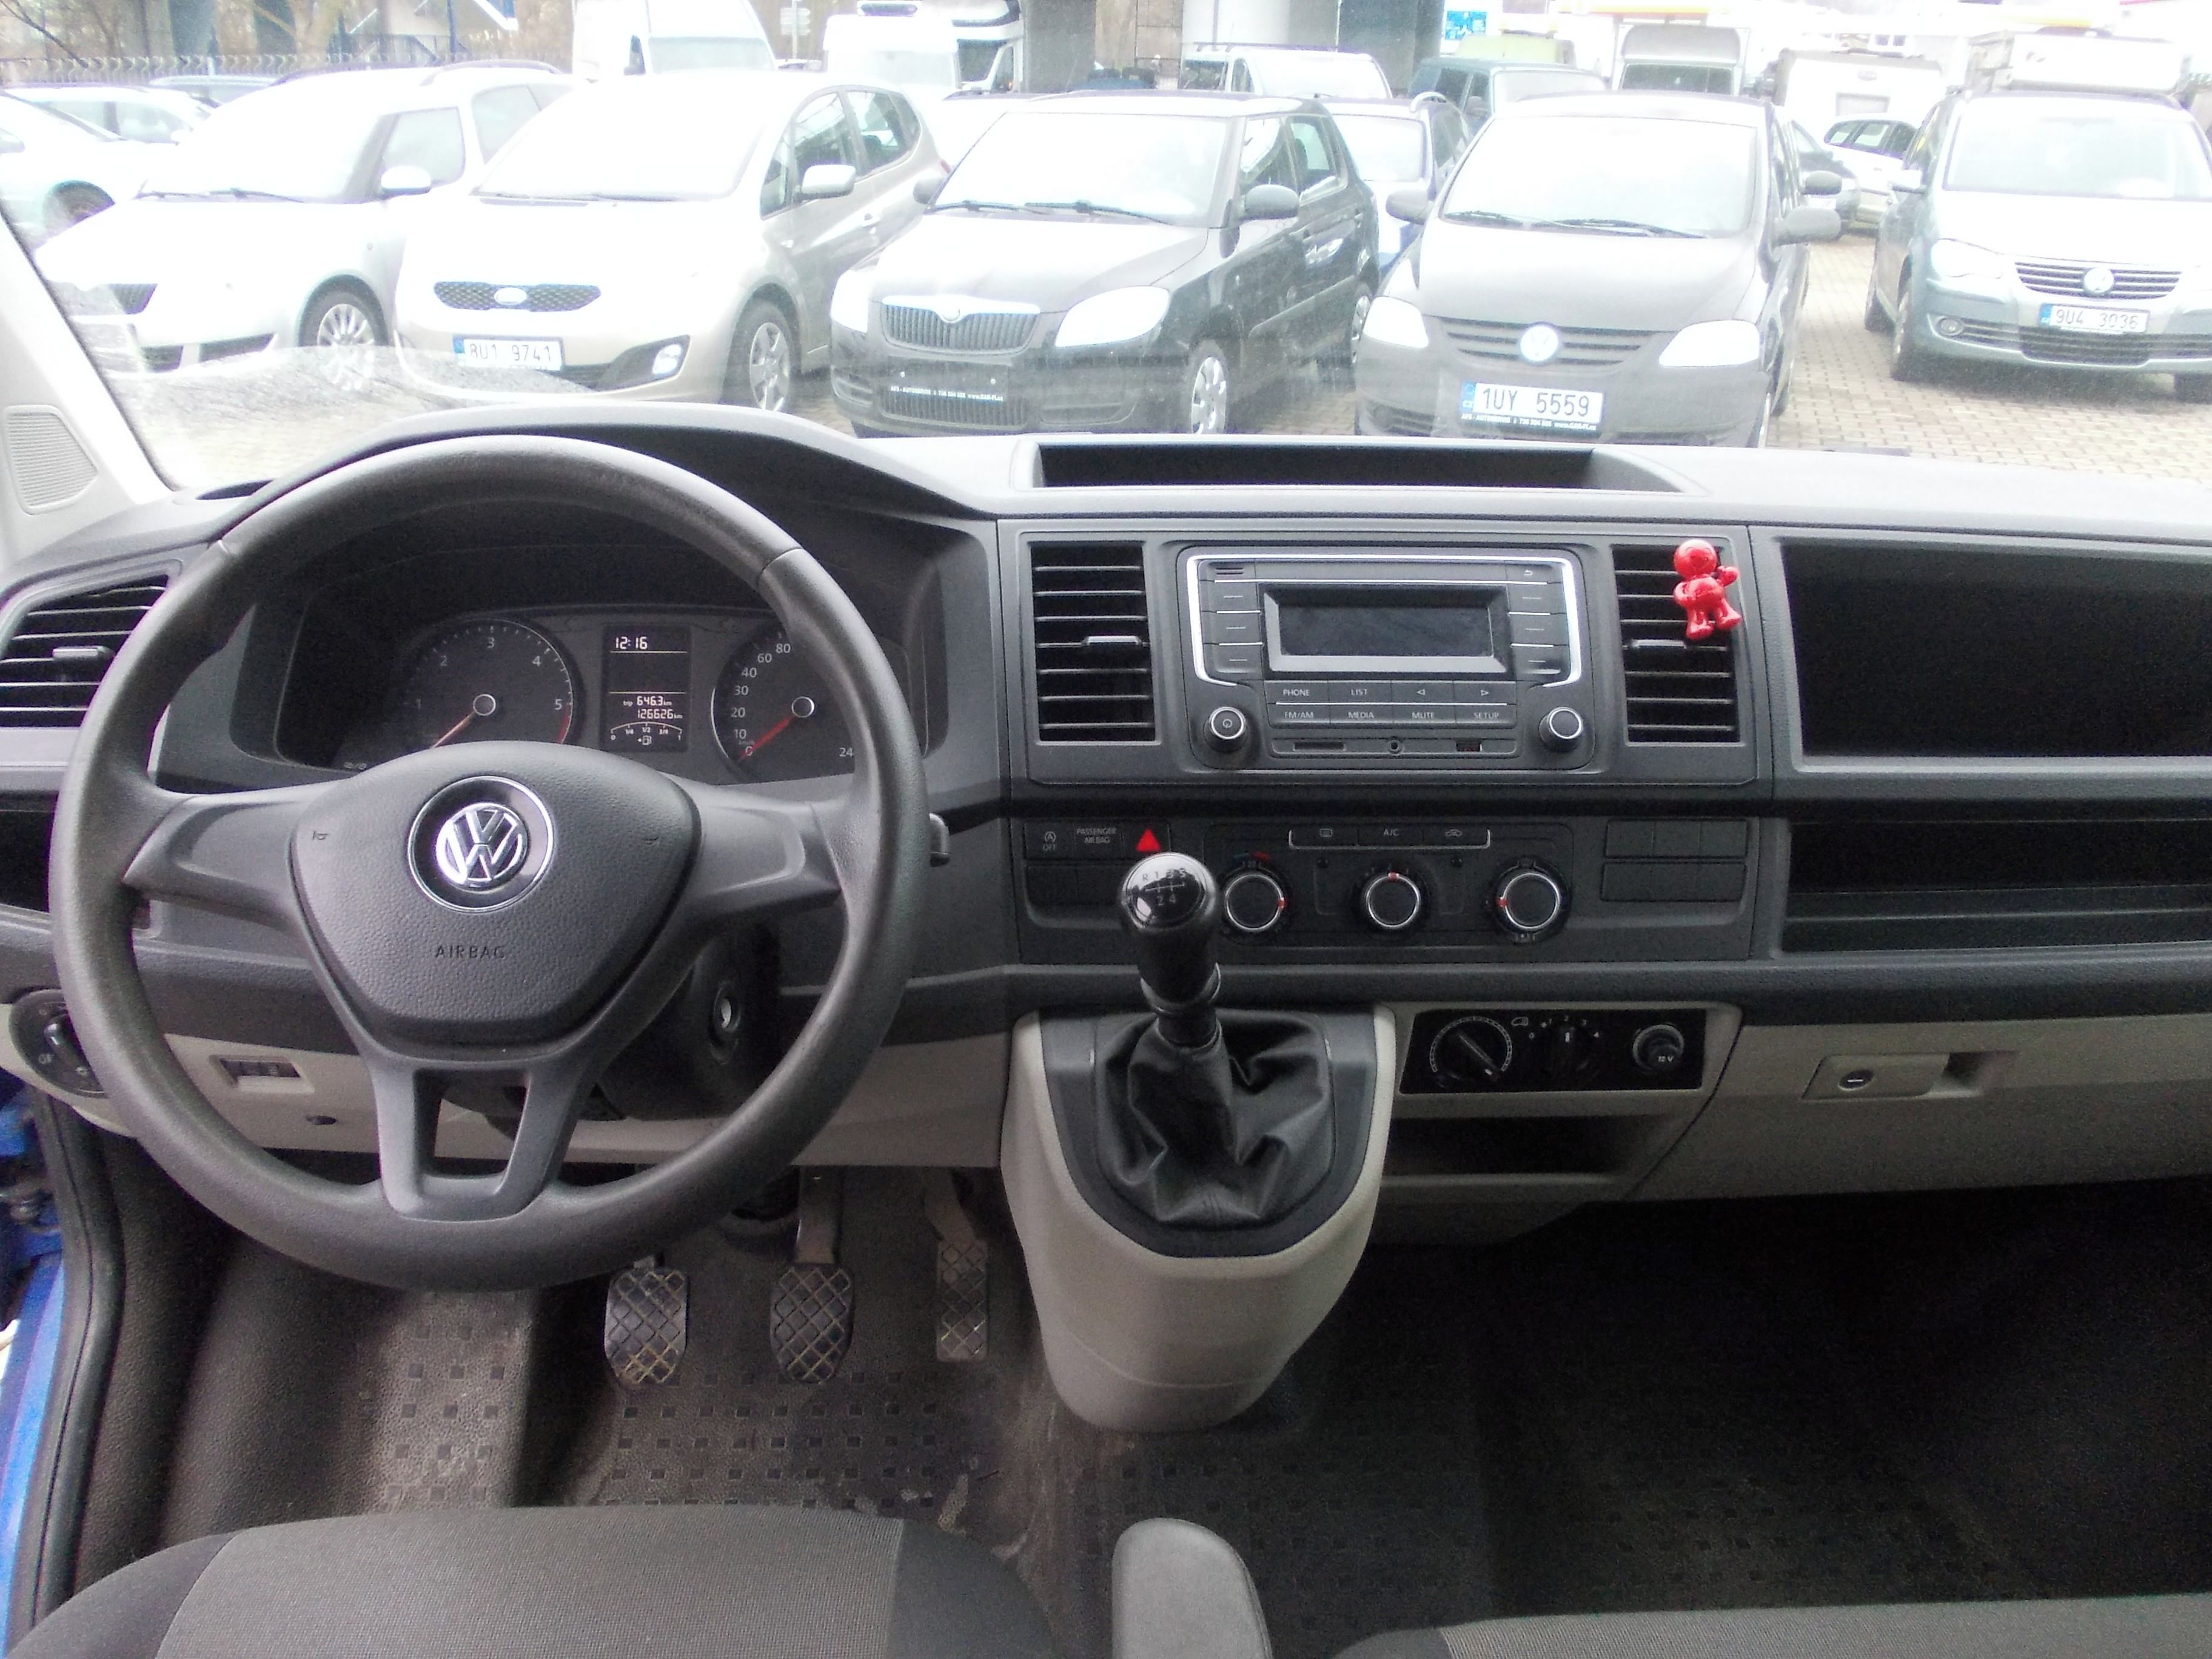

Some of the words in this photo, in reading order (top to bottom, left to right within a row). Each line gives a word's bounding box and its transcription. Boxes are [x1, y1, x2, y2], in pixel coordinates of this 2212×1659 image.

[2056, 309, 2083, 324] 9U4
[2100, 313, 2138, 329] 3036
[469, 343, 497, 359] 8U1
[512, 344, 551, 361] 9741
[1483, 388, 1518, 411] 1UY
[1537, 392, 1589, 417] 5559
[488, 637, 495, 648] 3
[615, 637, 648, 649] 12:16
[776, 643, 791, 654] 80
[440, 655, 447, 666] 2
[532, 655, 541, 666] 4
[758, 653, 772, 663] 60
[742, 668, 757, 677] 40
[734, 685, 749, 695] 30
[1282, 688, 1310, 697] PHONE
[555, 699, 561, 710] 5
[637, 709, 673, 719] 126626
[731, 707, 745, 718] 20
[734, 729, 746, 739] 10
[1169, 894, 1176, 903] 4
[435, 945, 506, 959] AIRBAG
